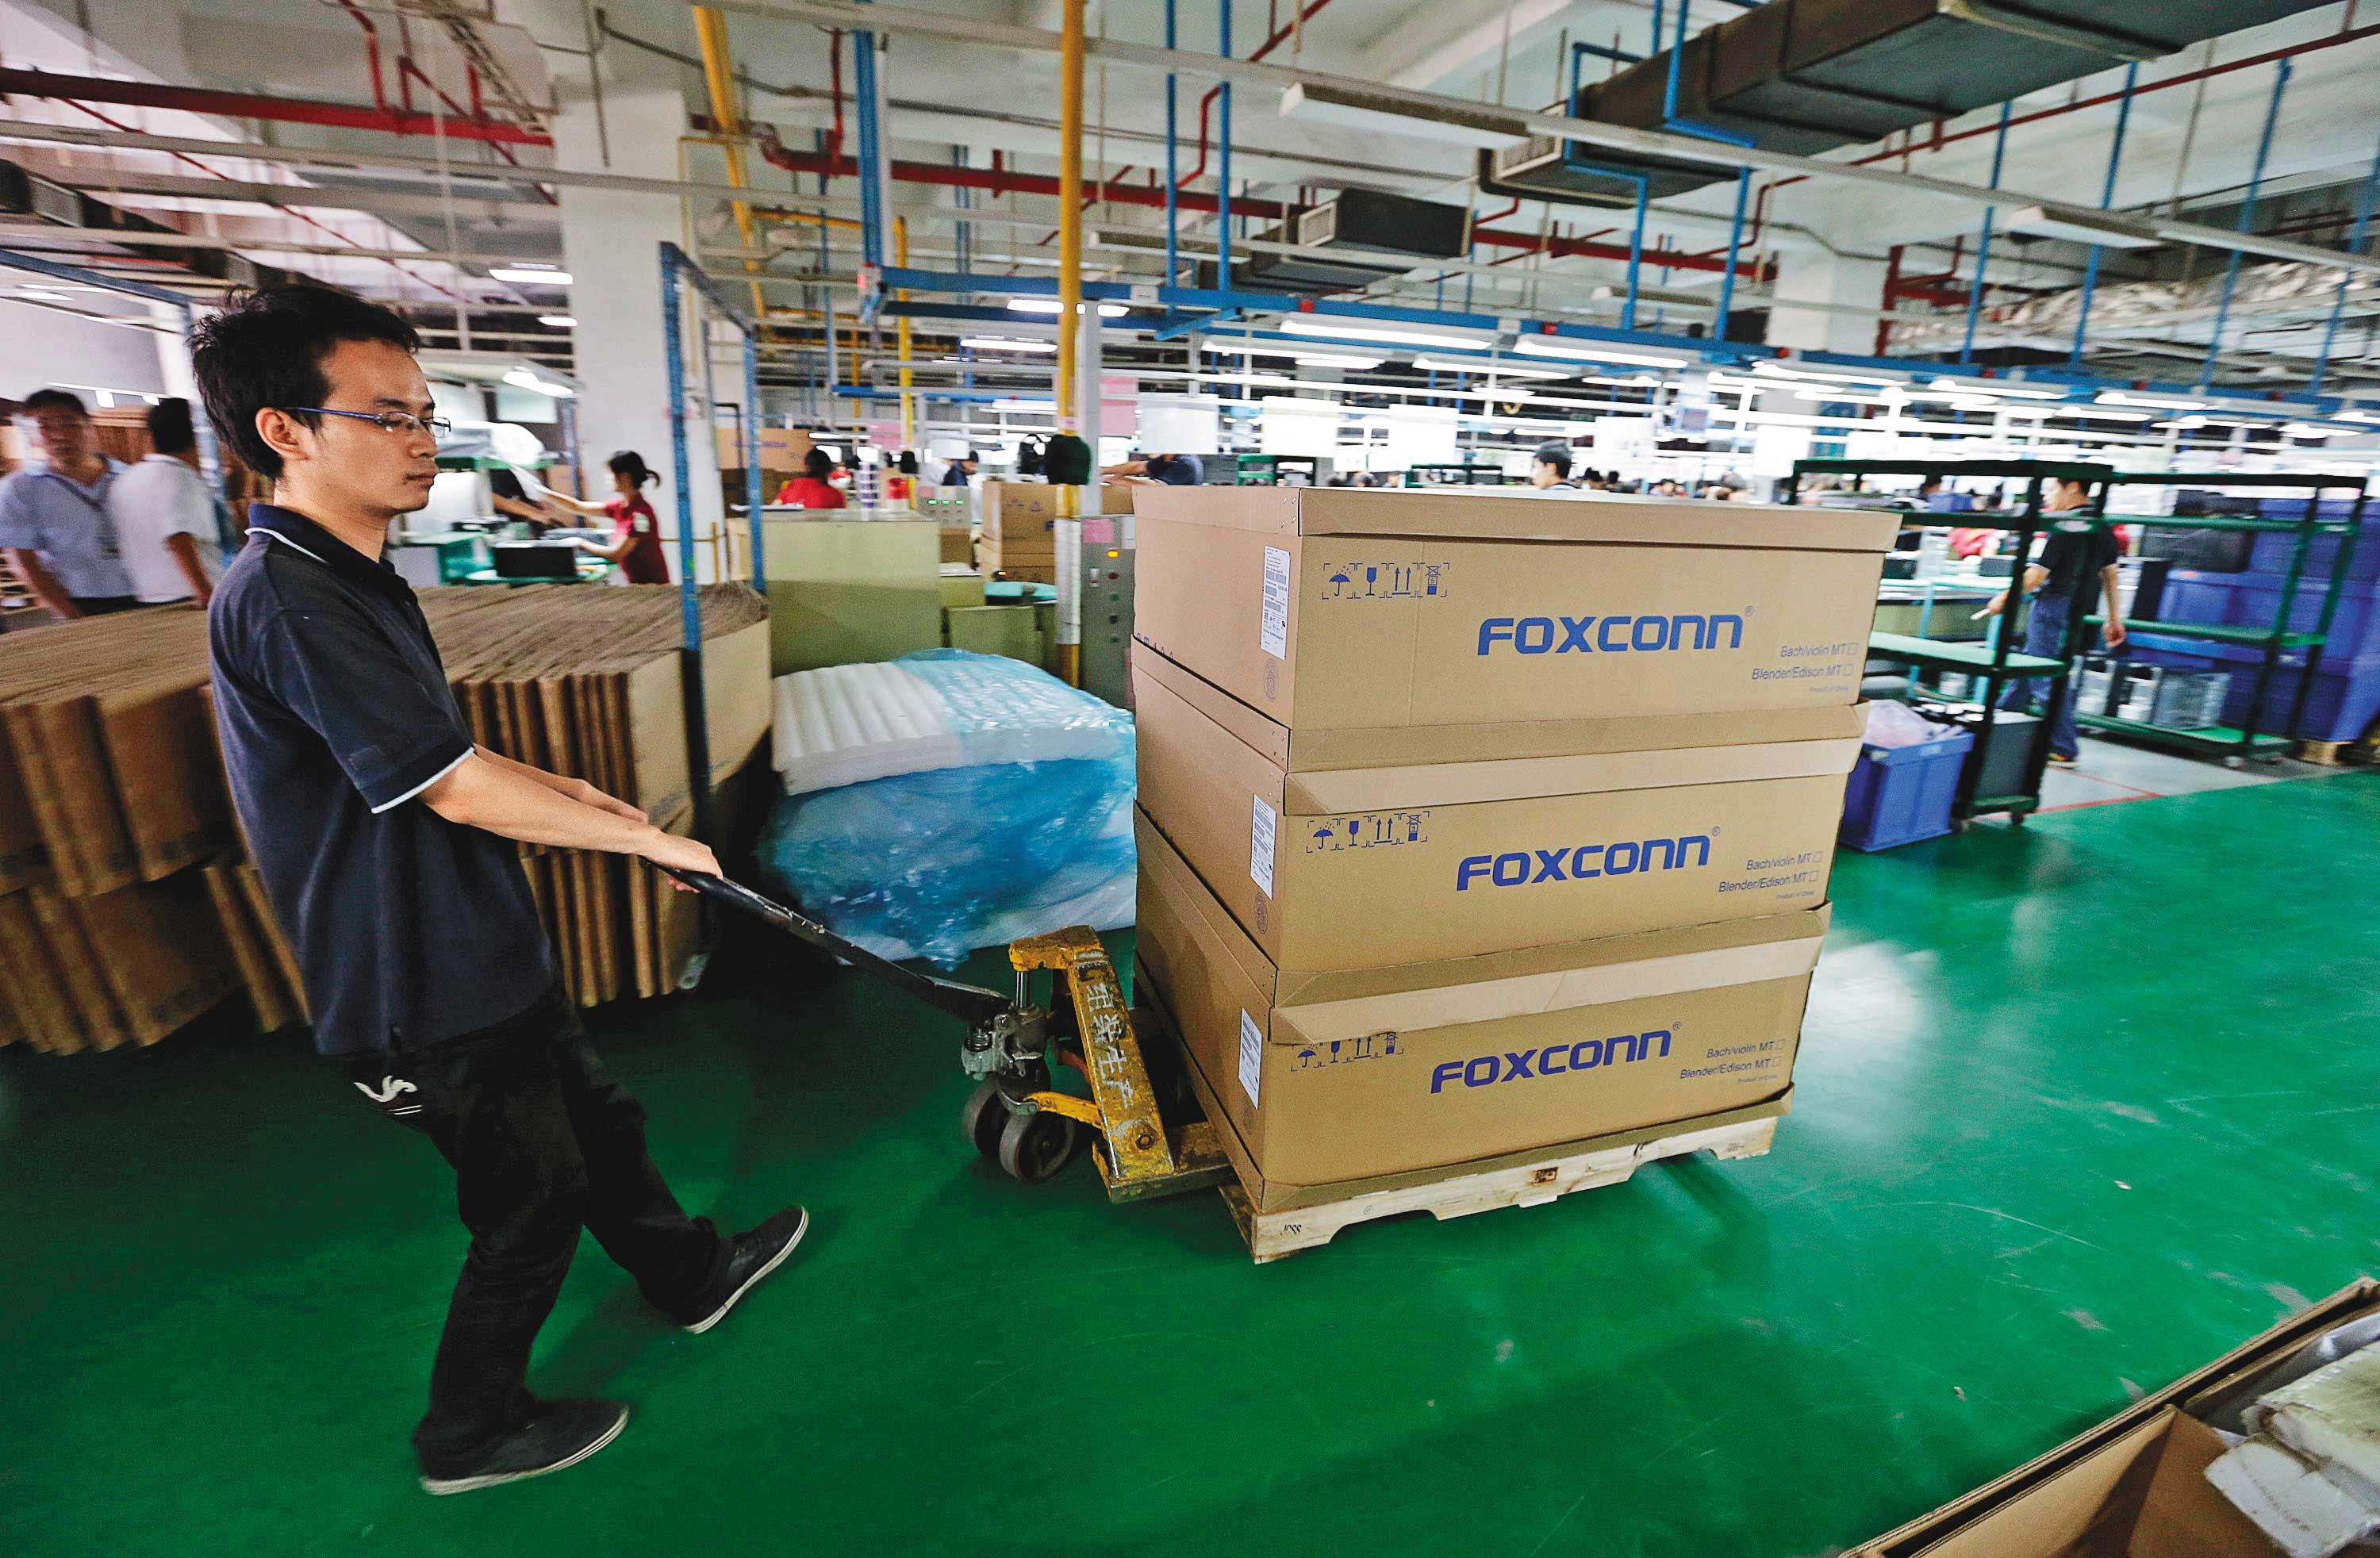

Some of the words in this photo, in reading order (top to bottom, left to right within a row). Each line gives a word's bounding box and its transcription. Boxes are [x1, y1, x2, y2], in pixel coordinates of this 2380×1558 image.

[1477, 614, 1743, 656] FOXCONN
[1780, 645, 1829, 658] Bach/violin
[1831, 643, 1847, 656] MT
[1752, 666, 1824, 680] Blender/Edison
[1826, 664, 1843, 677] MT
[1457, 835, 1710, 892] FOXCONN
[1746, 856, 1795, 870] Bach/violin
[1797, 853, 1812, 864] MT
[1718, 877, 1791, 892] Blender/Edison
[1792, 872, 1809, 883] MT
[1086, 982, 1134, 1109] 组装生产
[1706, 1044, 1756, 1058] Bach/violin
[1759, 1041, 1775, 1051] MT
[1430, 1030, 1672, 1094] FOXCONN
[1679, 1061, 1752, 1079] Blender/Edison
[1755, 1058, 1771, 1069] MT
